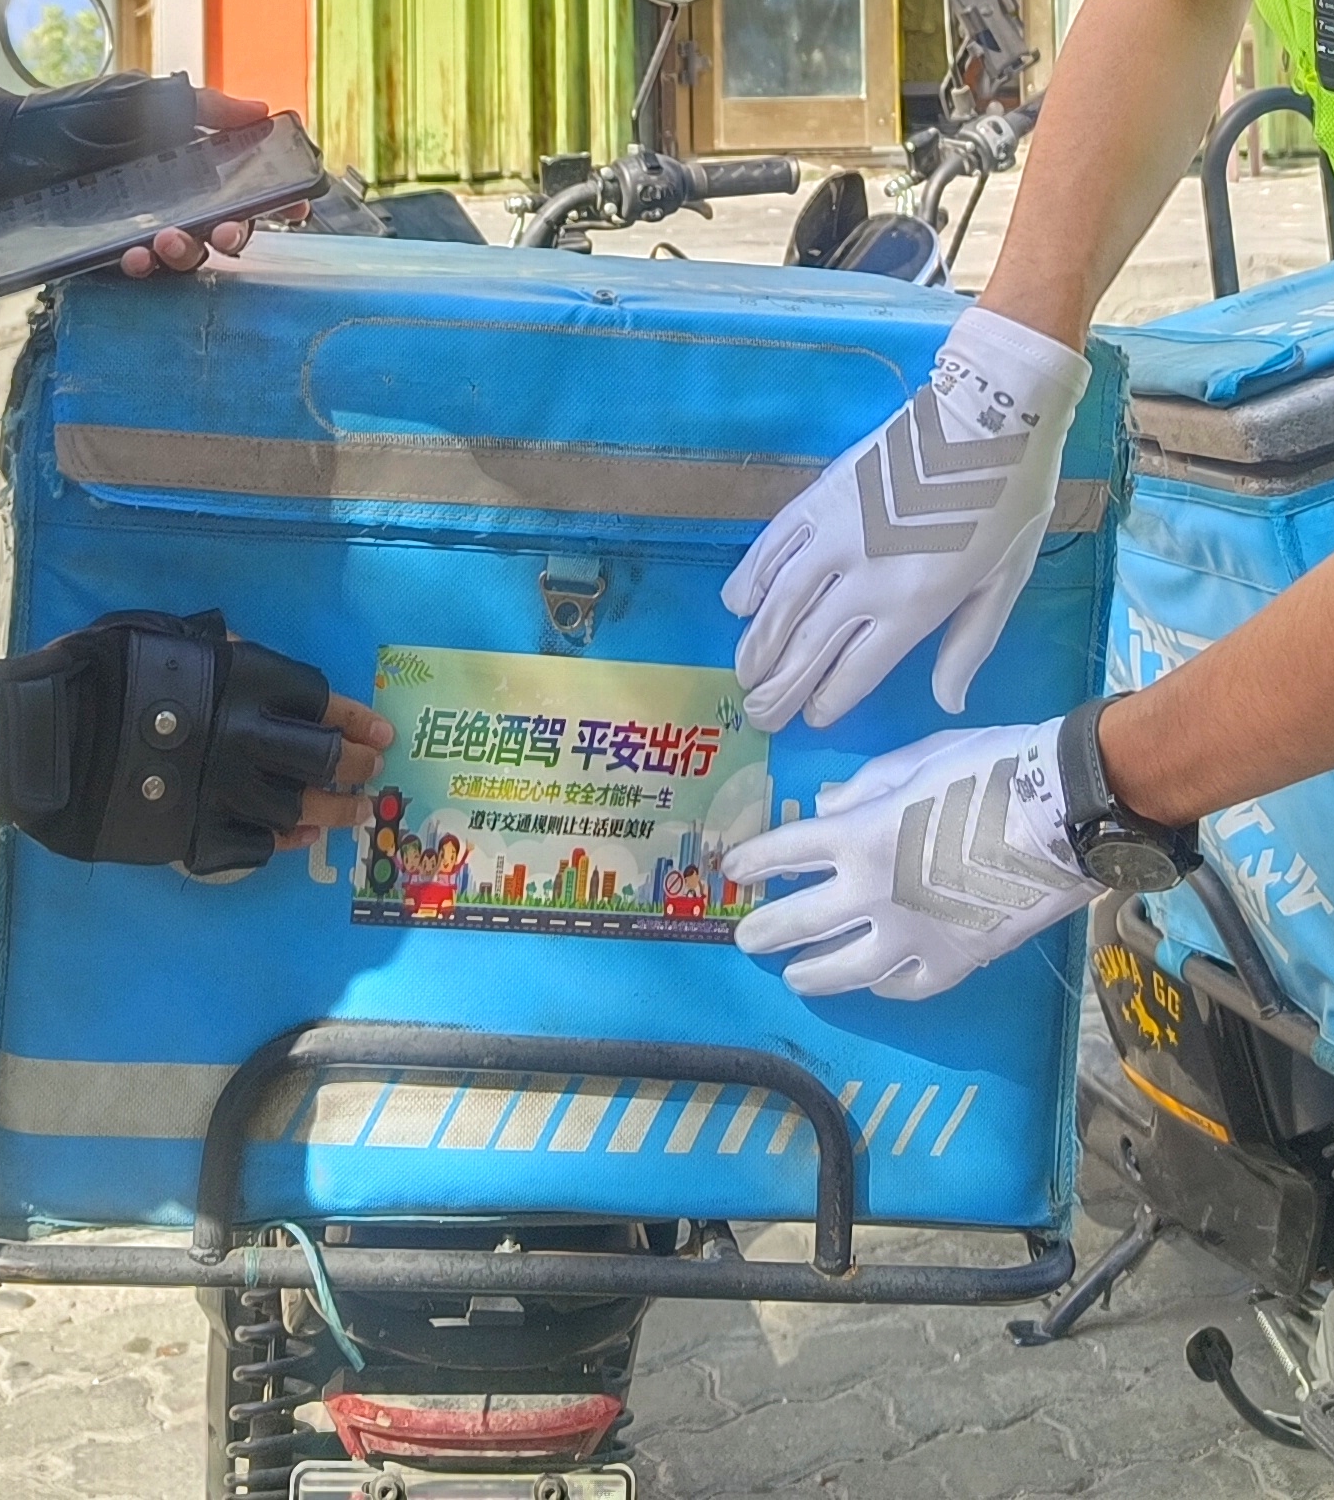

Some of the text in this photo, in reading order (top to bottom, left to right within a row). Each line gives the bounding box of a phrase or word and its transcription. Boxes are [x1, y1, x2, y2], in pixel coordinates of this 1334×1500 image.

[410, 706, 721, 778] 拒绝酒驾 平安出行
[449, 773, 675, 810] 交通法规记心中 安全才能伴一生
[467, 809, 656, 840] 遵守交通规则让生活更美好
